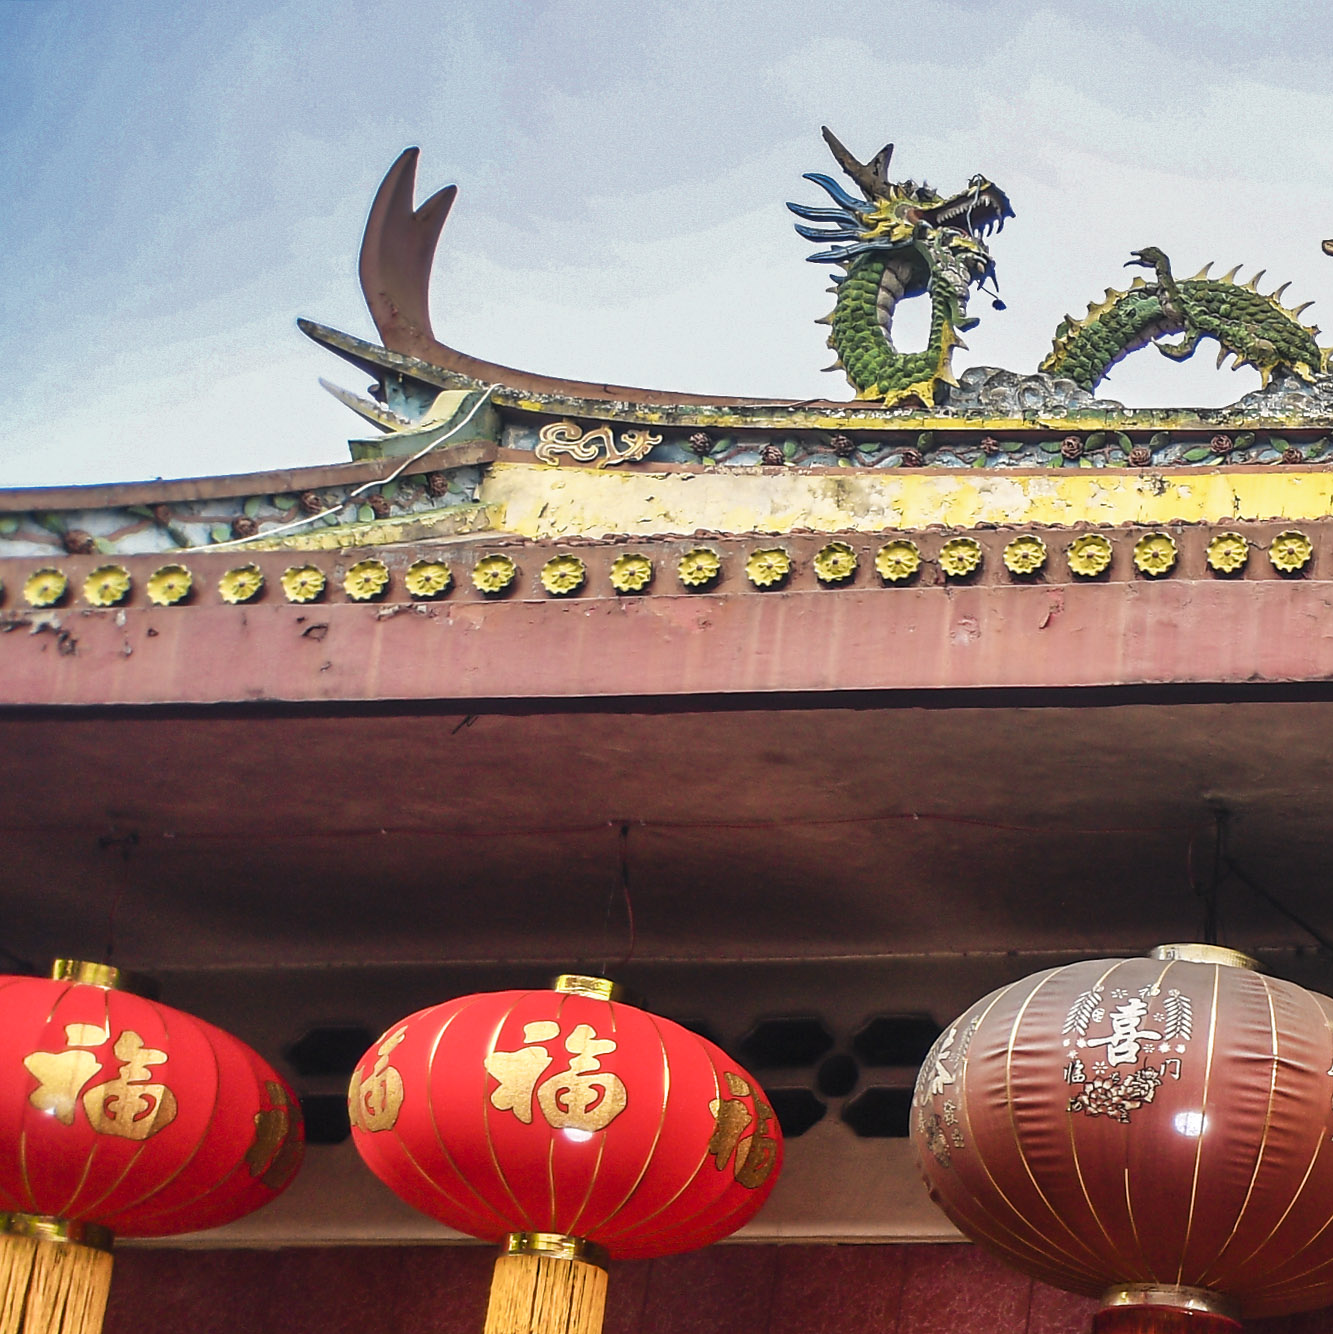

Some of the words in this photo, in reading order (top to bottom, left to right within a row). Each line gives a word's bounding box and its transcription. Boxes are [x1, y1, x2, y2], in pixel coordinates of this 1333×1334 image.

[484, 1020, 628, 1131] 福
[1064, 1060, 1087, 1085] 临
[1160, 1058, 1182, 1081] 门
[1087, 998, 1163, 1067] 喜
[23, 1023, 178, 1141] 福
